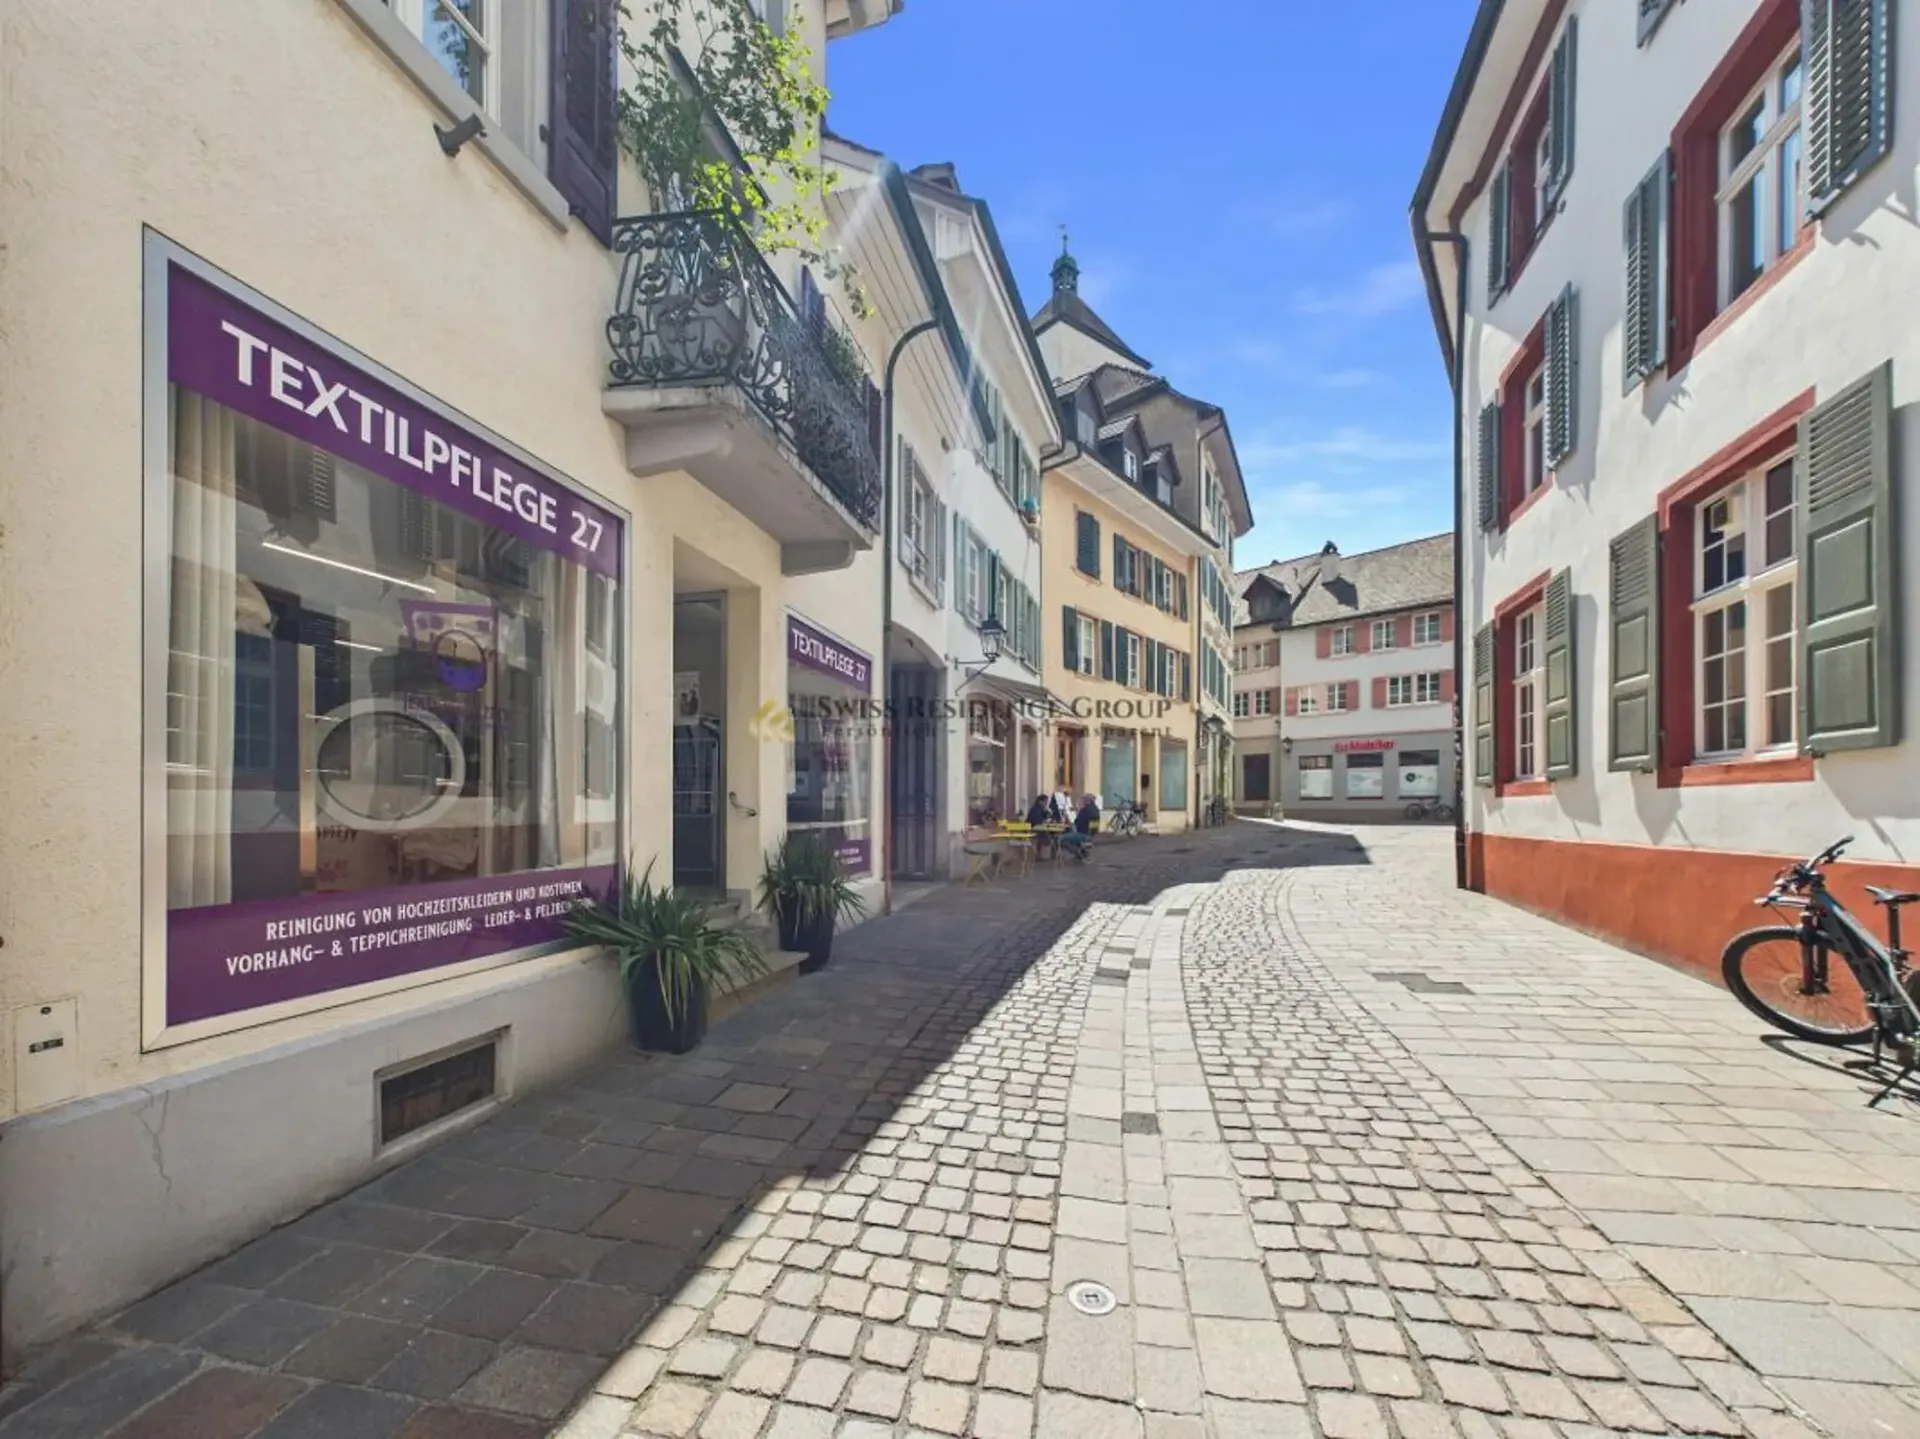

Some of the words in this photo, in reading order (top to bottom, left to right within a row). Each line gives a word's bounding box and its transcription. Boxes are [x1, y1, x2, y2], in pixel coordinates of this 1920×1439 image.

[220, 319, 558, 535] TEXTILPFLEGE
[570, 510, 604, 553] 27
[791, 627, 855, 678] TEXTILPFLEGE
[856, 662, 867, 682] 27
[225, 943, 325, 976] VORHANG-
[330, 940, 344, 957] &
[349, 917, 473, 954] TEPPICHREINIGUNG
[524, 906, 533, 921] &
[265, 911, 356, 941] REINIGUNG
[362, 906, 392, 926] VON
[396, 889, 513, 920] HOCHZEITSKLEIDERN
[515, 886, 536, 902] UND
